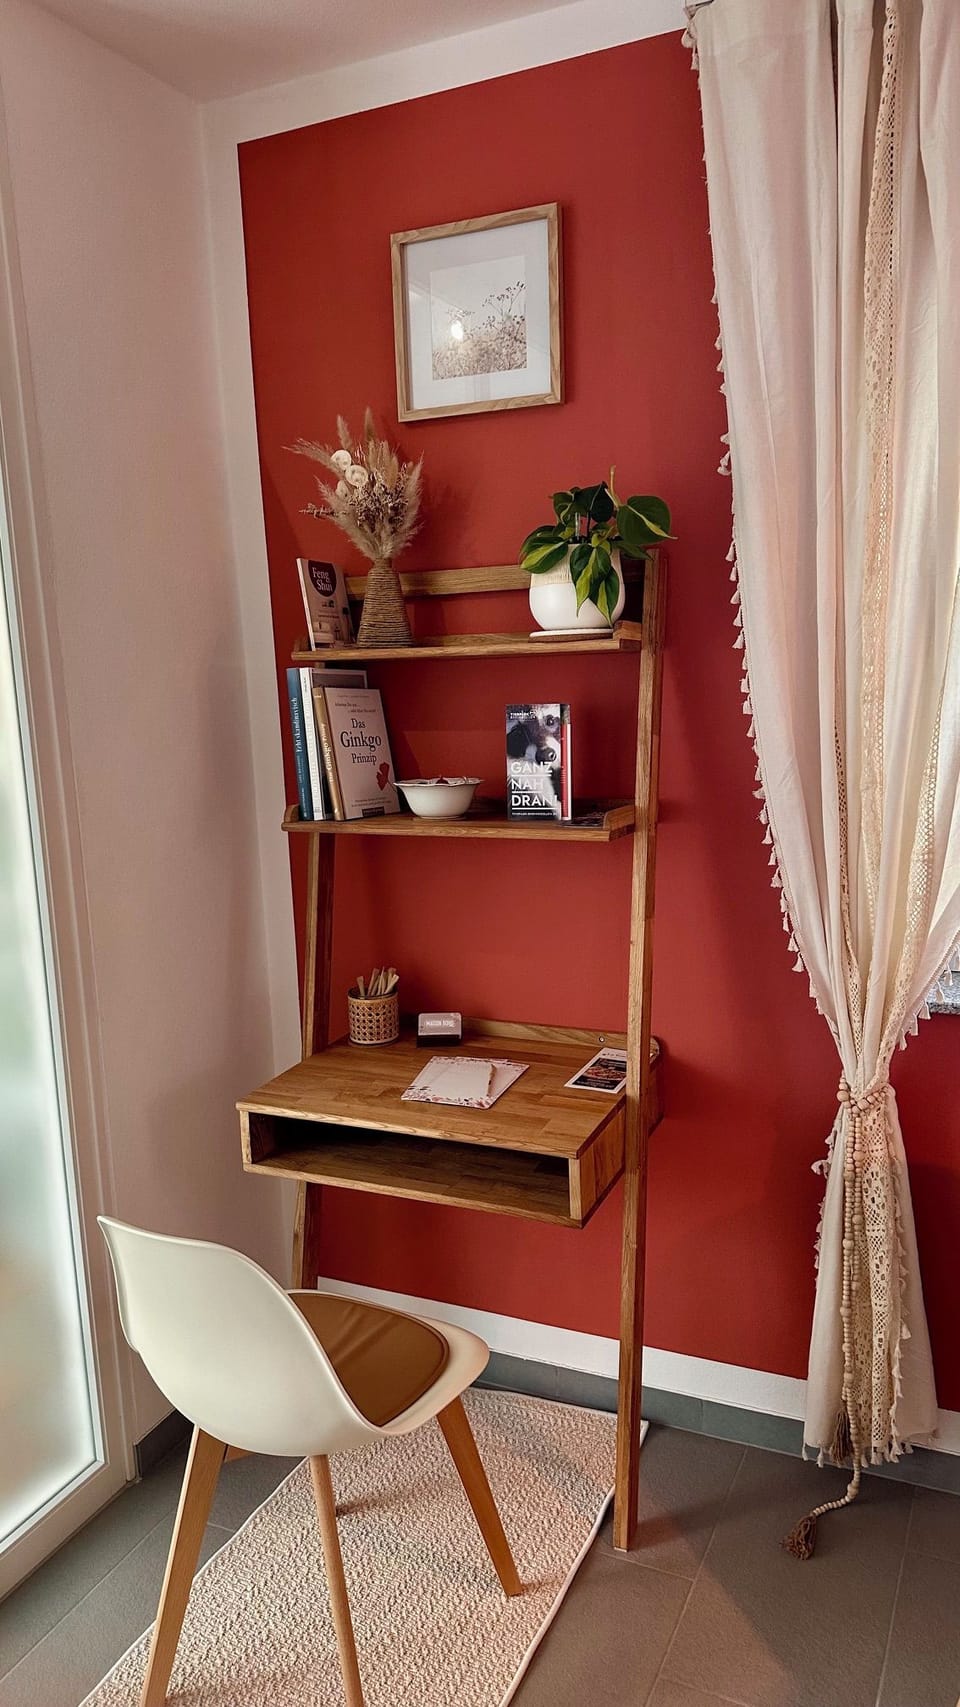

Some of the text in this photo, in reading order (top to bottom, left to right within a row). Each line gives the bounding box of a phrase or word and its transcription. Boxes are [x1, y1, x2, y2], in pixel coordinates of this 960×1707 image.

[312, 568, 330, 582] Feng
[351, 718, 366, 729] Das
[340, 731, 382, 753] Ginkgo
[324, 743, 335, 771] Ginkgo
[351, 753, 377, 766] Prinzip
[511, 761, 553, 774] GANZ
[511, 778, 543, 790] NAH
[511, 794, 558, 807] DRAN!
